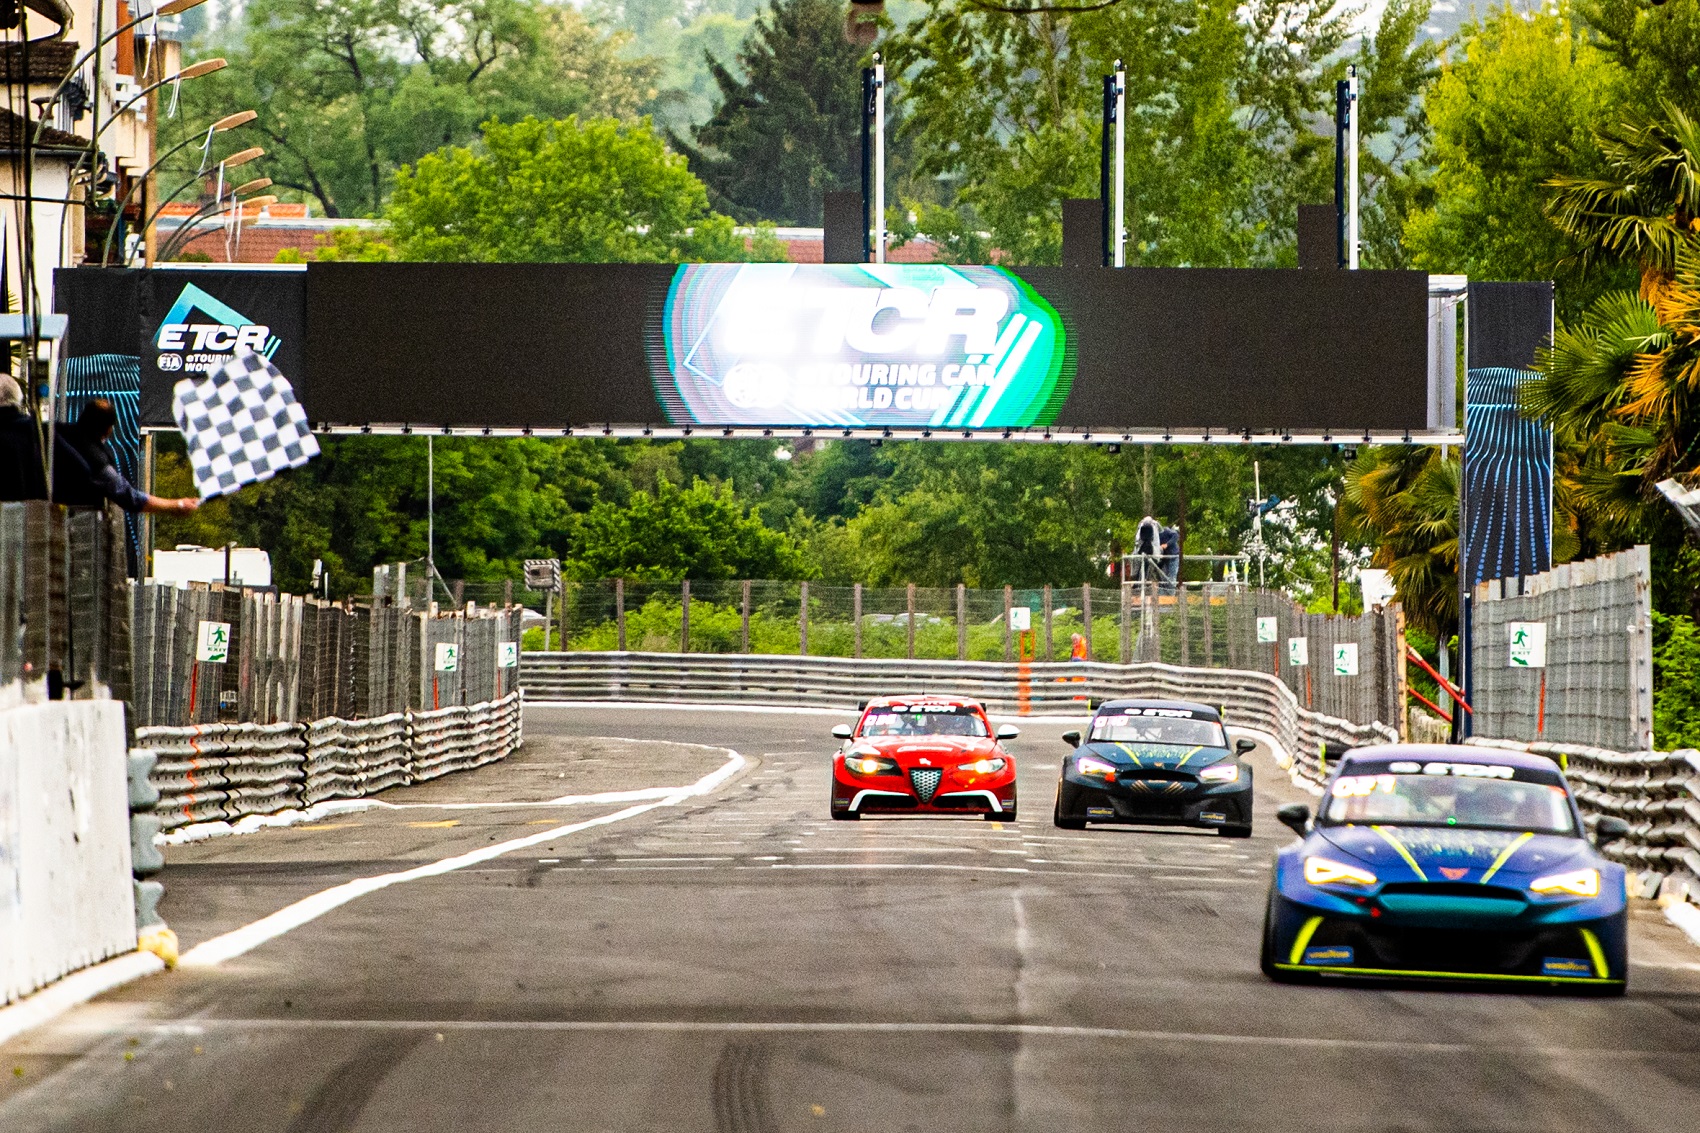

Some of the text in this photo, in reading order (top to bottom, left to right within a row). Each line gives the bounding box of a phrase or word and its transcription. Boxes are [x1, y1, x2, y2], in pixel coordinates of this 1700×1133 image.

[157, 324, 270, 351] ETCR
[186, 354, 234, 363] eTOURIN
[185, 363, 212, 372] WOR
[941, 363, 996, 386] CAR
